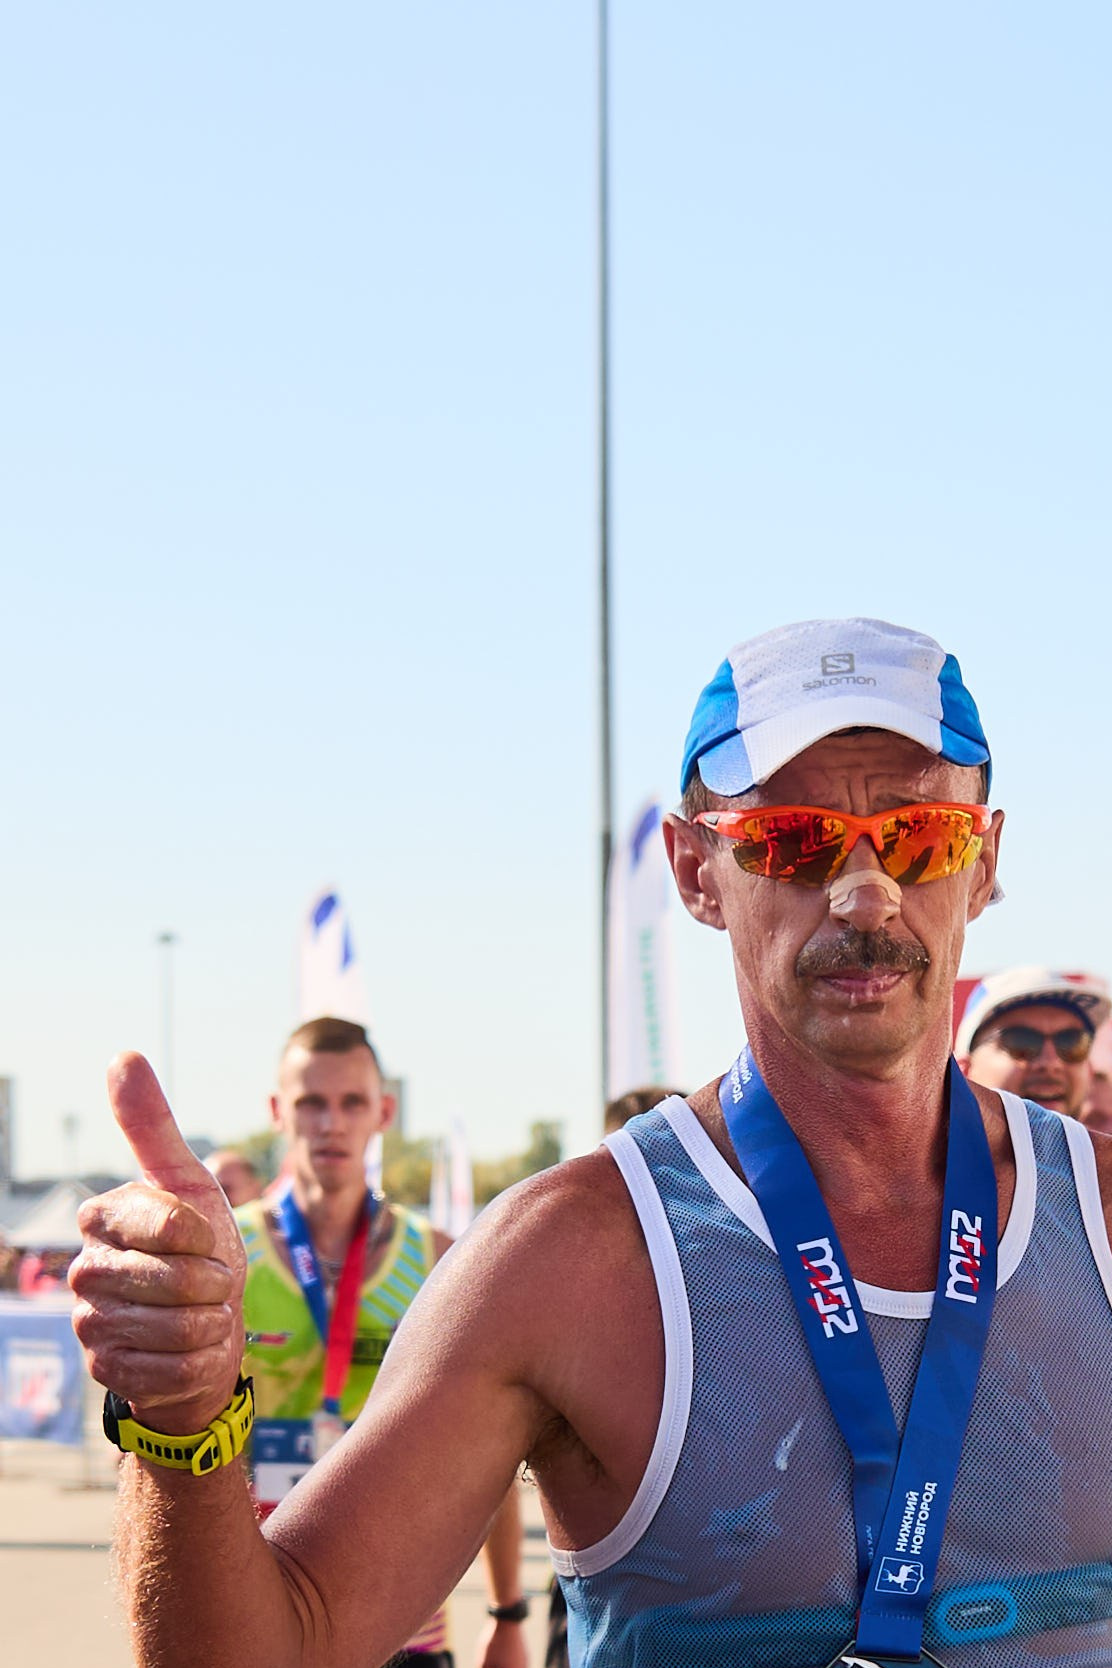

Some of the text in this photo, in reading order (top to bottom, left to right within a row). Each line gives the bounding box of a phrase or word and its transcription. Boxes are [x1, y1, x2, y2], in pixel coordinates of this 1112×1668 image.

[803, 676, 877, 691] salomon
[895, 1490, 920, 1553] НИЖНИЙ
[910, 1481, 938, 1556] НОВГОРОД
